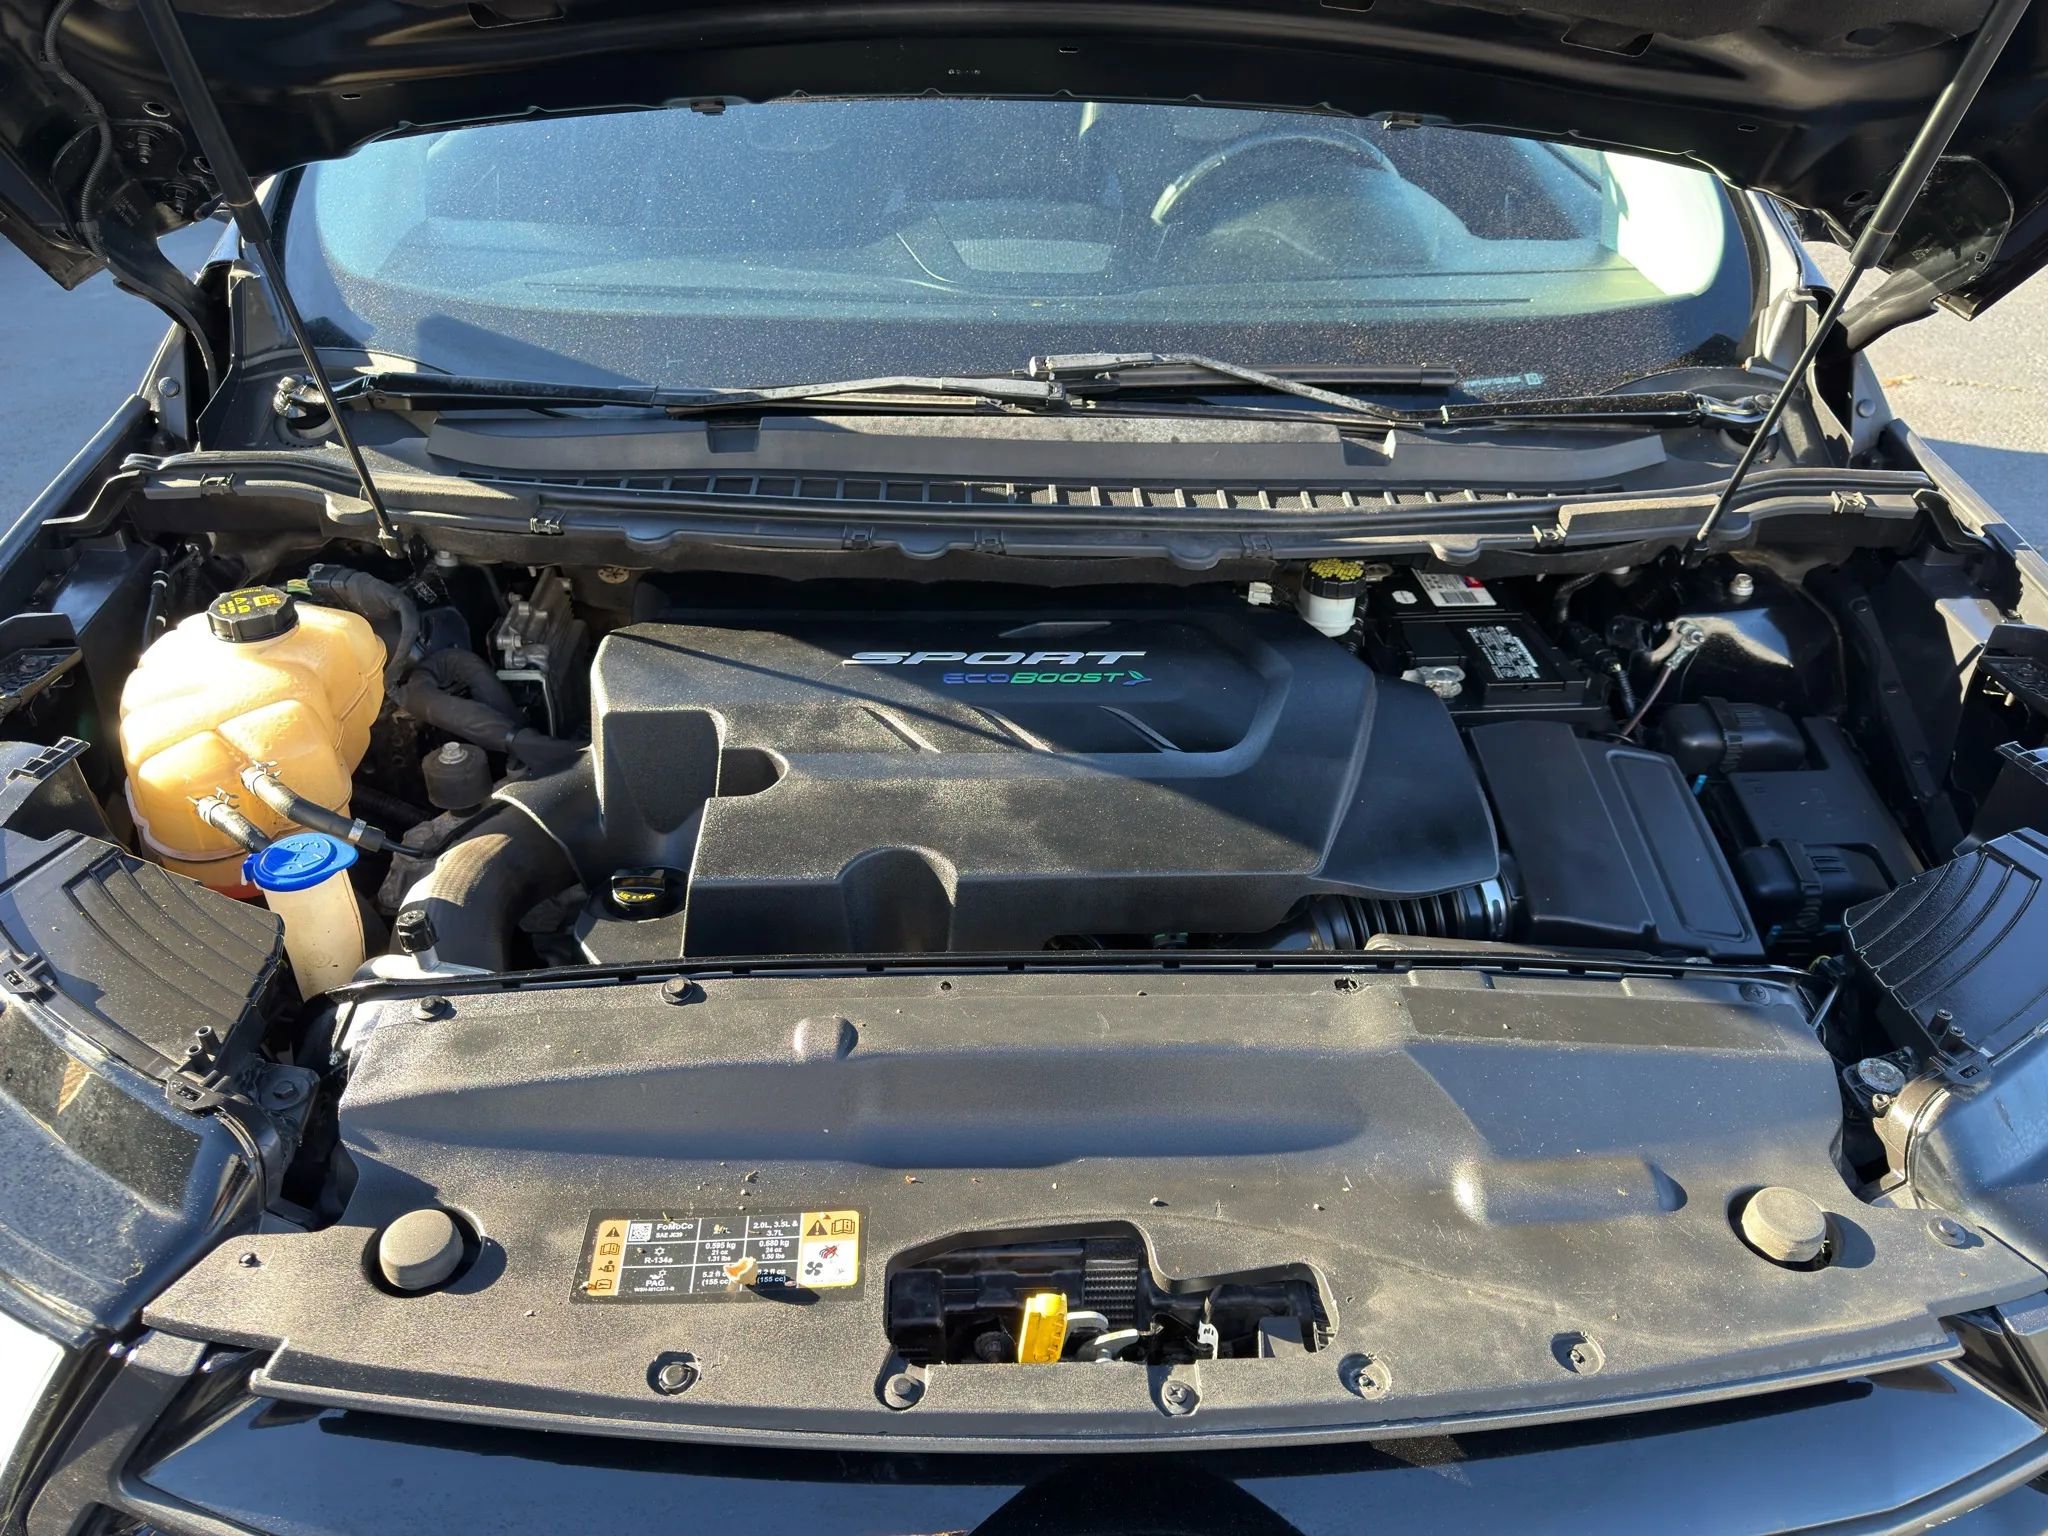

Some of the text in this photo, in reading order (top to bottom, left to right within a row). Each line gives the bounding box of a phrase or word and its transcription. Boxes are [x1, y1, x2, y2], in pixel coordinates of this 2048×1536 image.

[843, 651, 1147, 665] SPORT
[943, 672, 1125, 685] ECOBOOST
[657, 1222, 693, 1230] FoMoCo
[774, 1220, 791, 1228] 3.5L
[726, 1242, 736, 1250] kg
